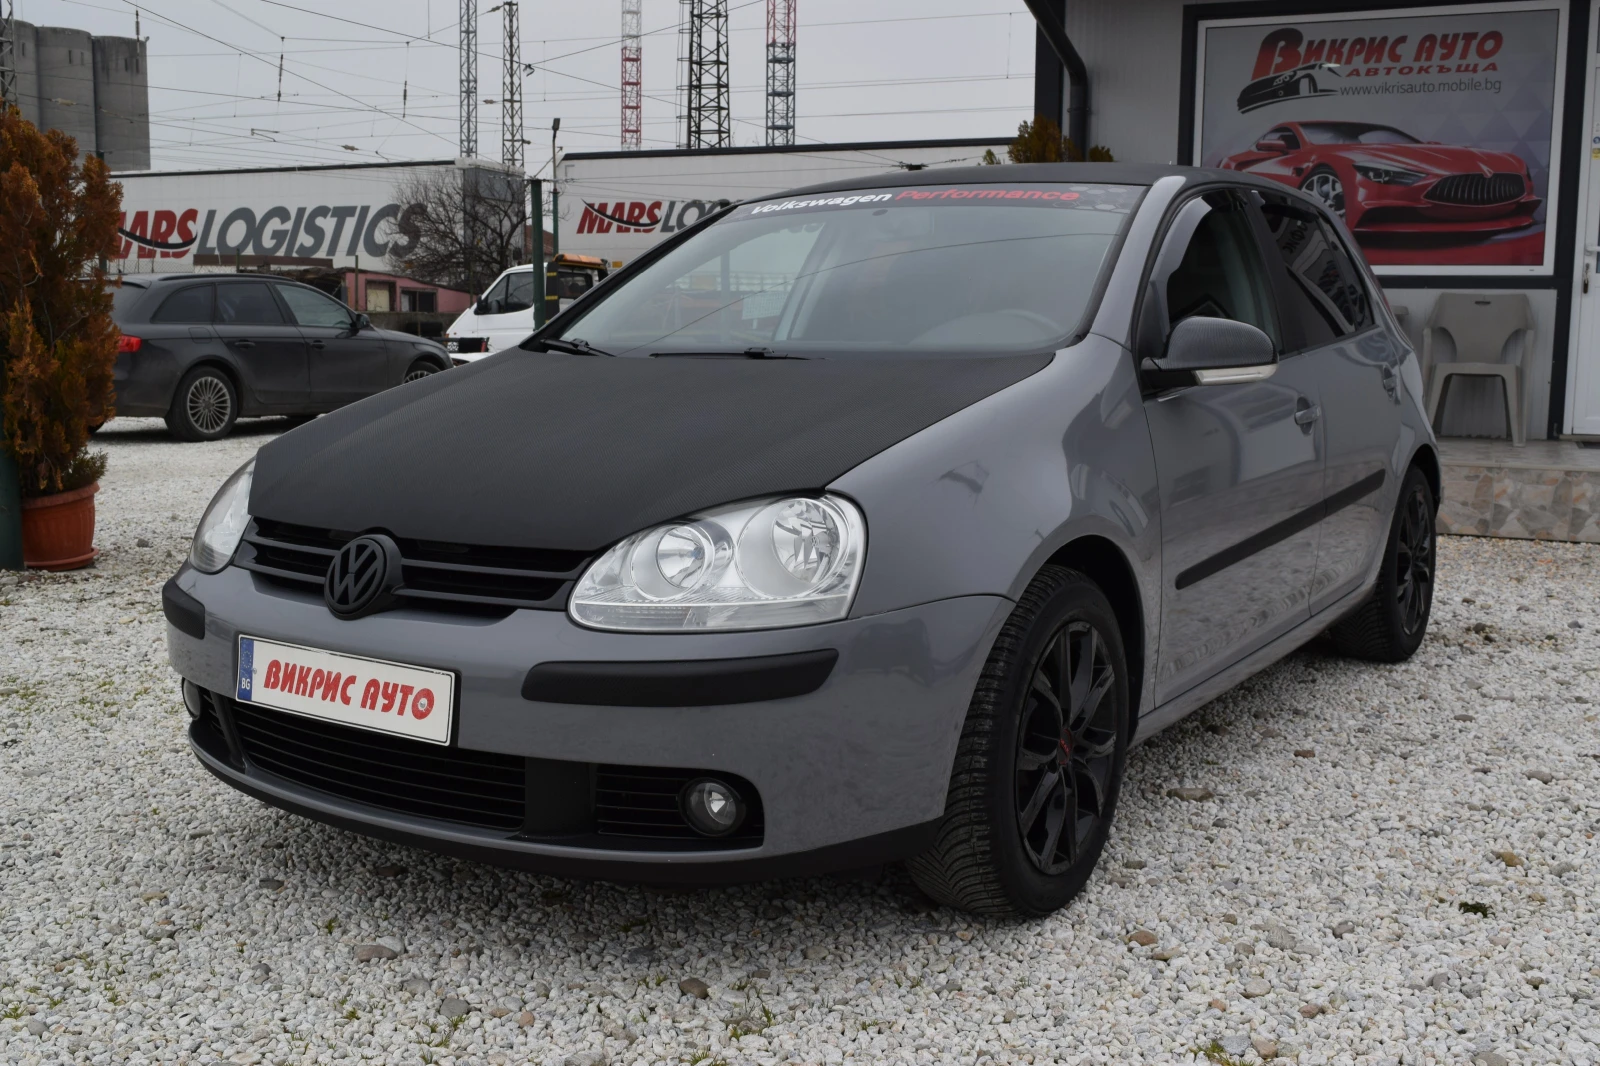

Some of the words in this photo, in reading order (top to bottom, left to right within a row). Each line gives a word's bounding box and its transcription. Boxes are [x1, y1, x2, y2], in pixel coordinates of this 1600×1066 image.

[1251, 28, 1408, 81] ВИКРИС
[1413, 31, 1504, 63] АУТО
[1345, 62, 1499, 78] АВТОКЪЩА
[1340, 78, 1502, 97] www.vikrisauto.mobile.bg
[751, 193, 892, 214] Volkswagen
[895, 189, 1080, 201] Performance
[241, 677, 251, 691] BG
[263, 659, 357, 705] ВИКРИС
[360, 678, 435, 720] АУТО
